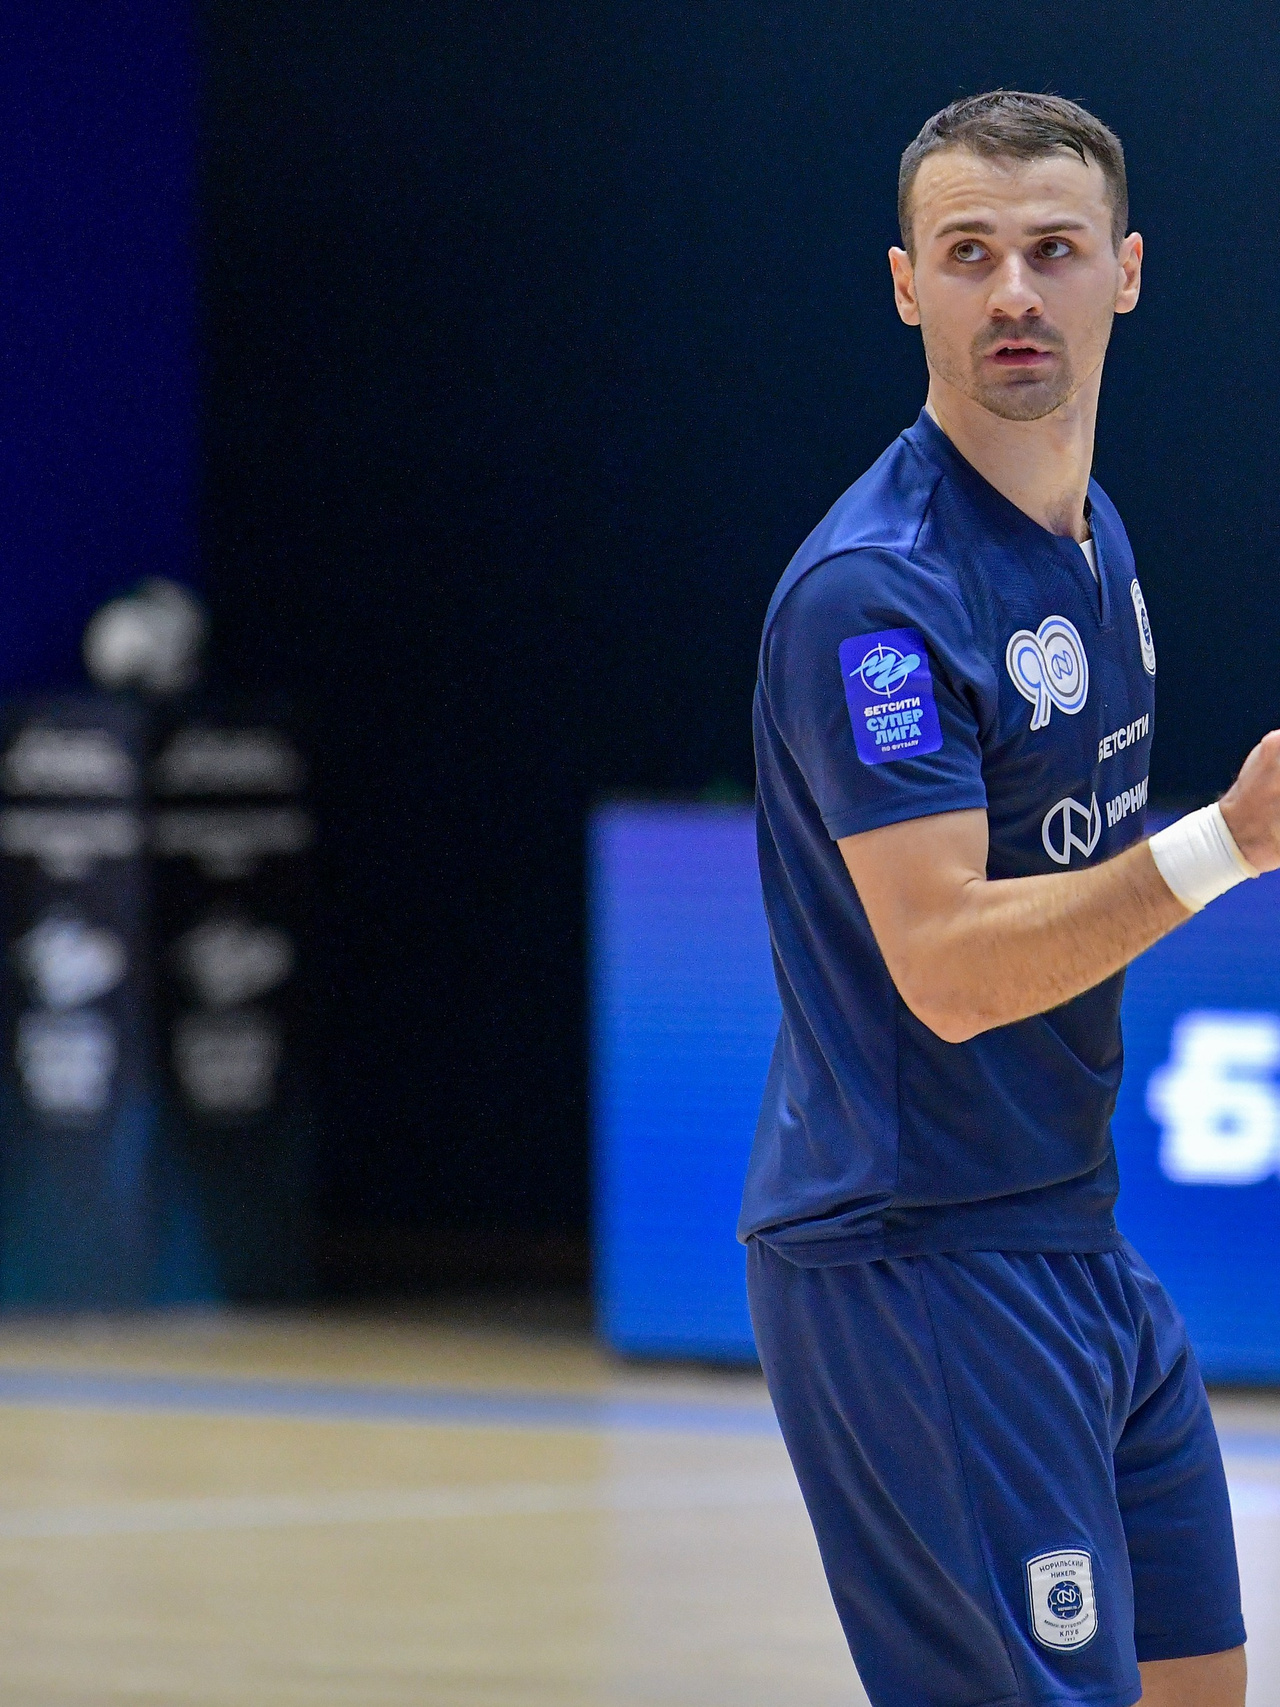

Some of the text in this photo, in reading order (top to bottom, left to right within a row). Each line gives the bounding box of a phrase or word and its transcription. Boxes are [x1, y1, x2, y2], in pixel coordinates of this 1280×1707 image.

[864, 697, 920, 717] БЕТСИТИ
[866, 709, 923, 732] СУПЕР
[875, 724, 922, 745] ЛИГА
[1098, 713, 1149, 763] БЕТСИТИ
[1039, 1560, 1084, 1573] НОРИЛЬСКИЙ
[1050, 1570, 1077, 1578] НИКЕЛЬ
[1059, 1629, 1079, 1637] КЛУБ
